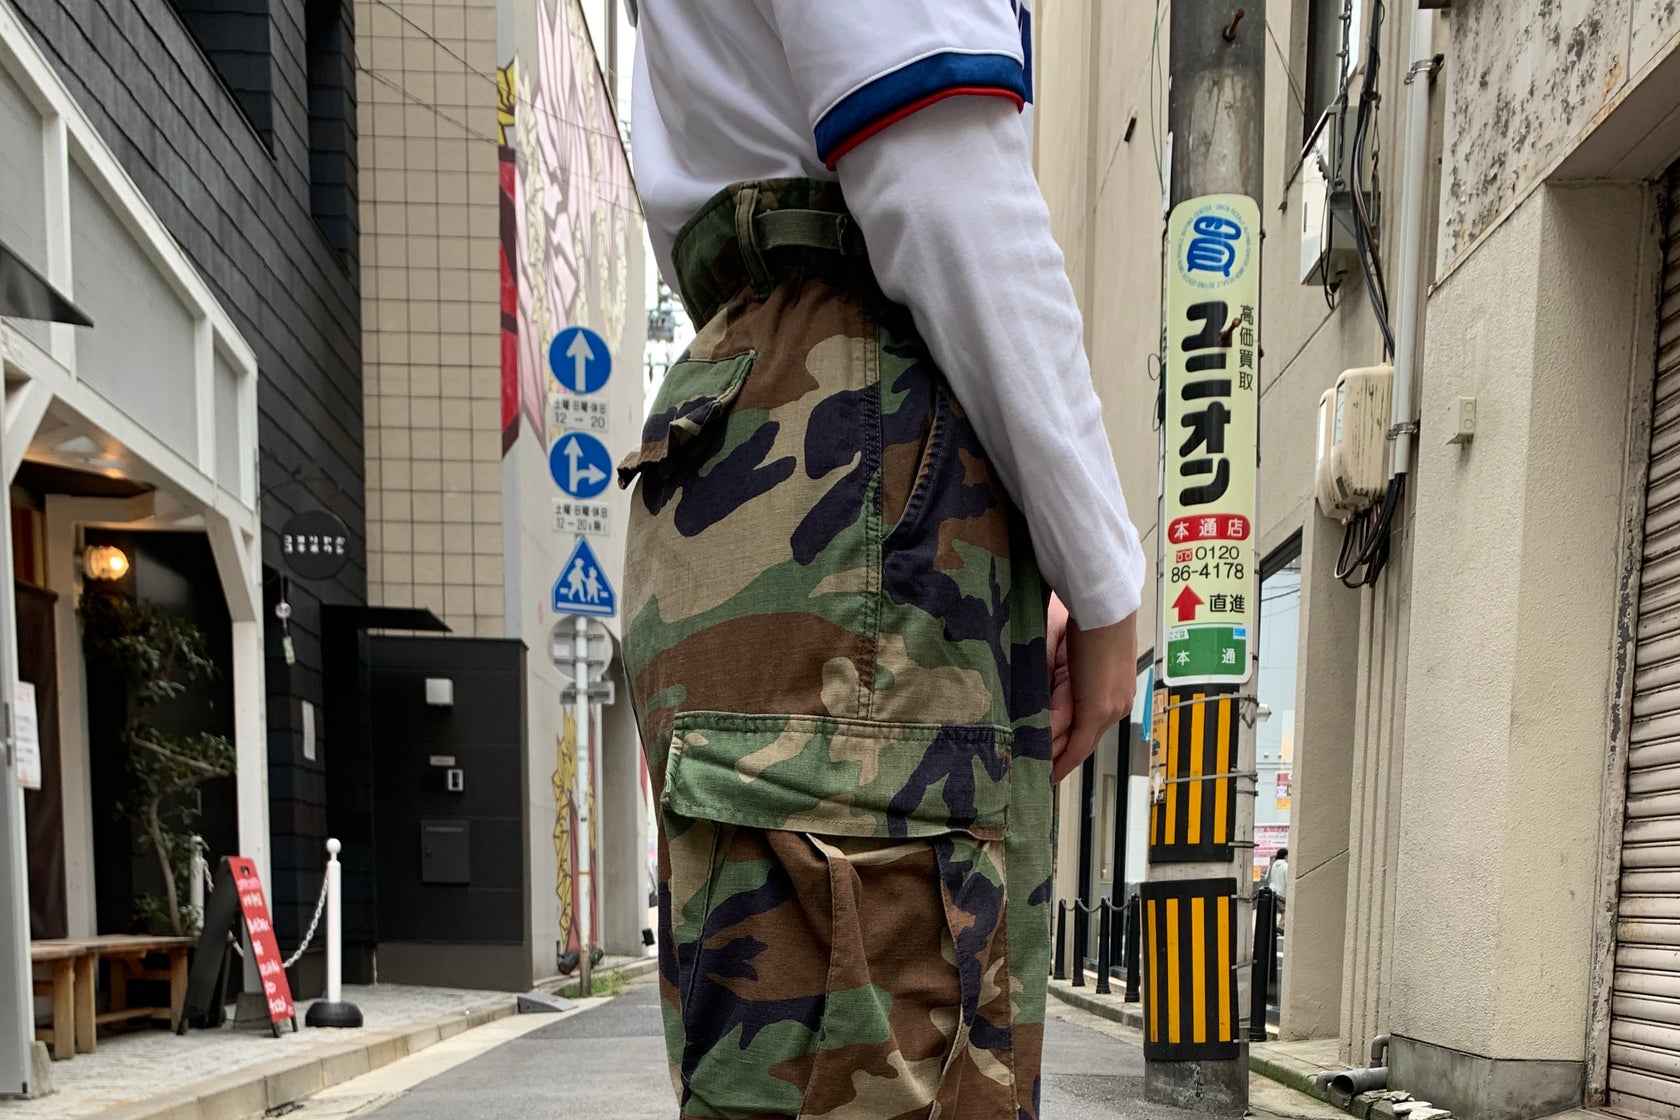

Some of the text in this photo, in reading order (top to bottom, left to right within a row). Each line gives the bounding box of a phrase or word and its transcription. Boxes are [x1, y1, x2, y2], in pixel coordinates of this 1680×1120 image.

[1238, 304, 1254, 391] 高価買取
[1179, 300, 1233, 507] ユニオン
[590, 415, 605, 429] 20
[1174, 518, 1243, 540] 本通店
[1195, 546, 1240, 560] 0120
[1171, 562, 1244, 583] 86-4178
[1209, 594, 1246, 613] 直進
